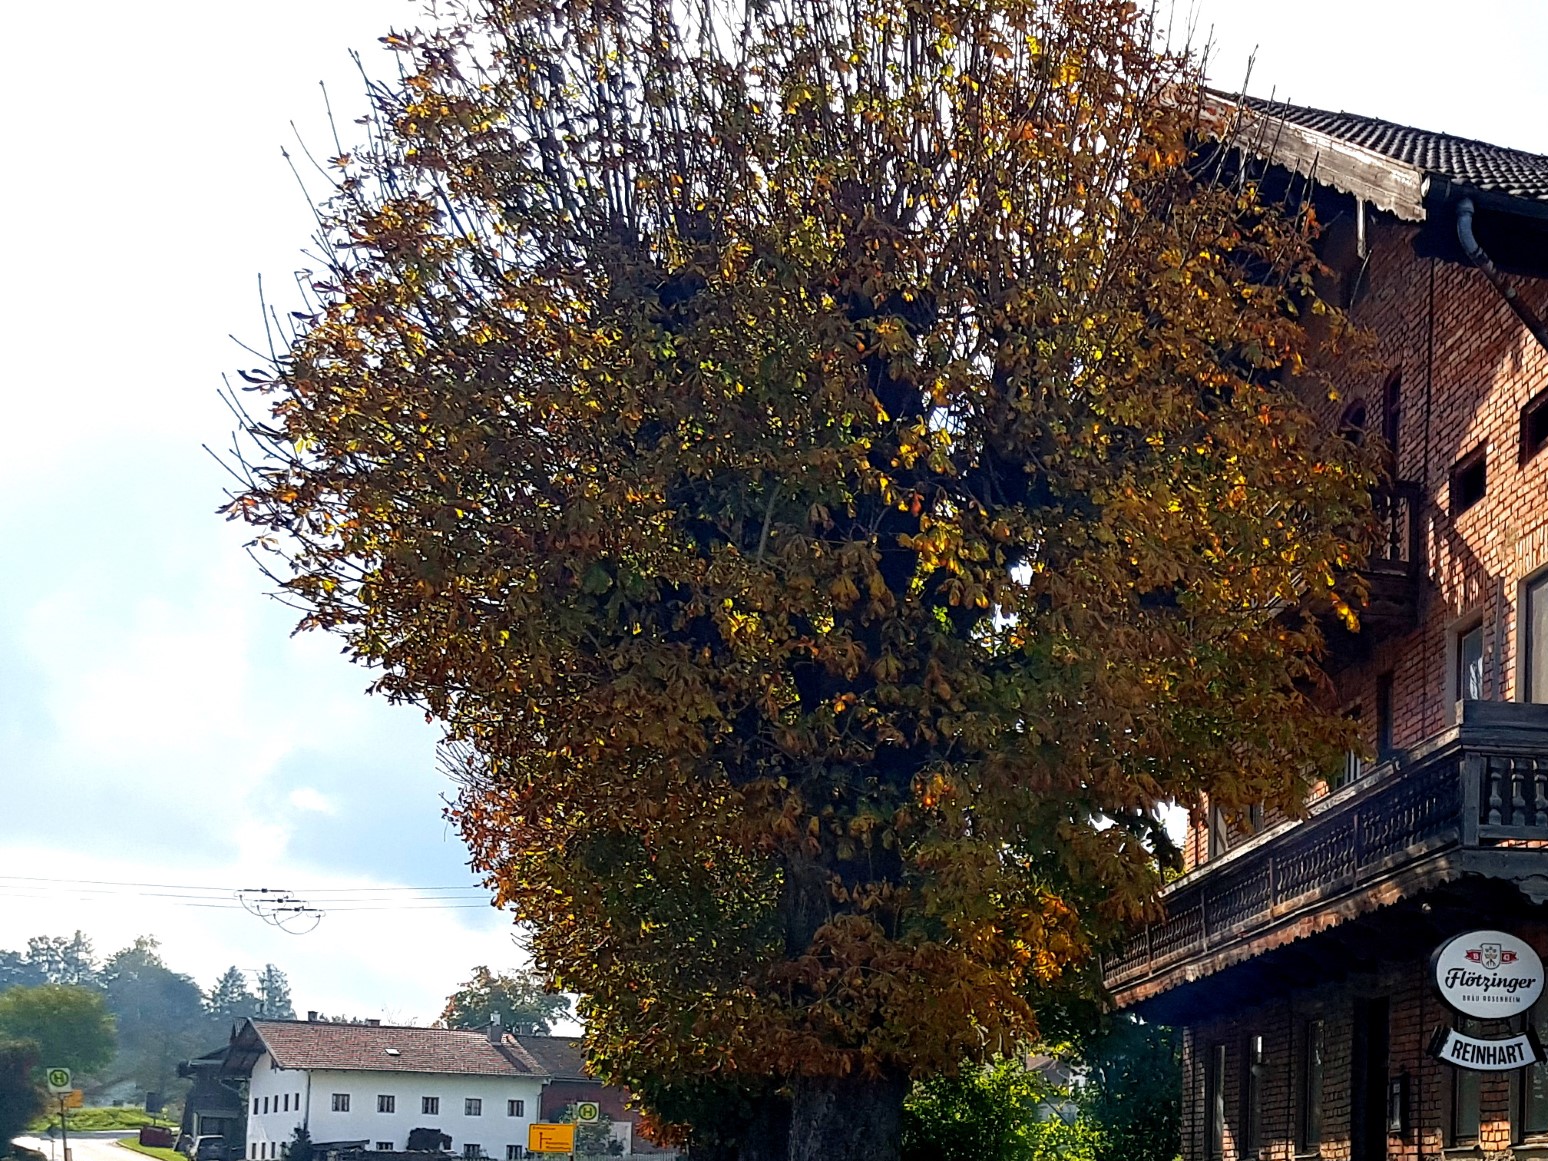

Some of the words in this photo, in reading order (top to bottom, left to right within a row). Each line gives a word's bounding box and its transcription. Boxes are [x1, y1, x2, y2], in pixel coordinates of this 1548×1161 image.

[1445, 967, 1536, 993] Flötzinger
[1462, 994, 1480, 1002] BRÄU
[1482, 995, 1521, 1003] ROSENHEIM
[1451, 1039, 1524, 1065] REINHART
